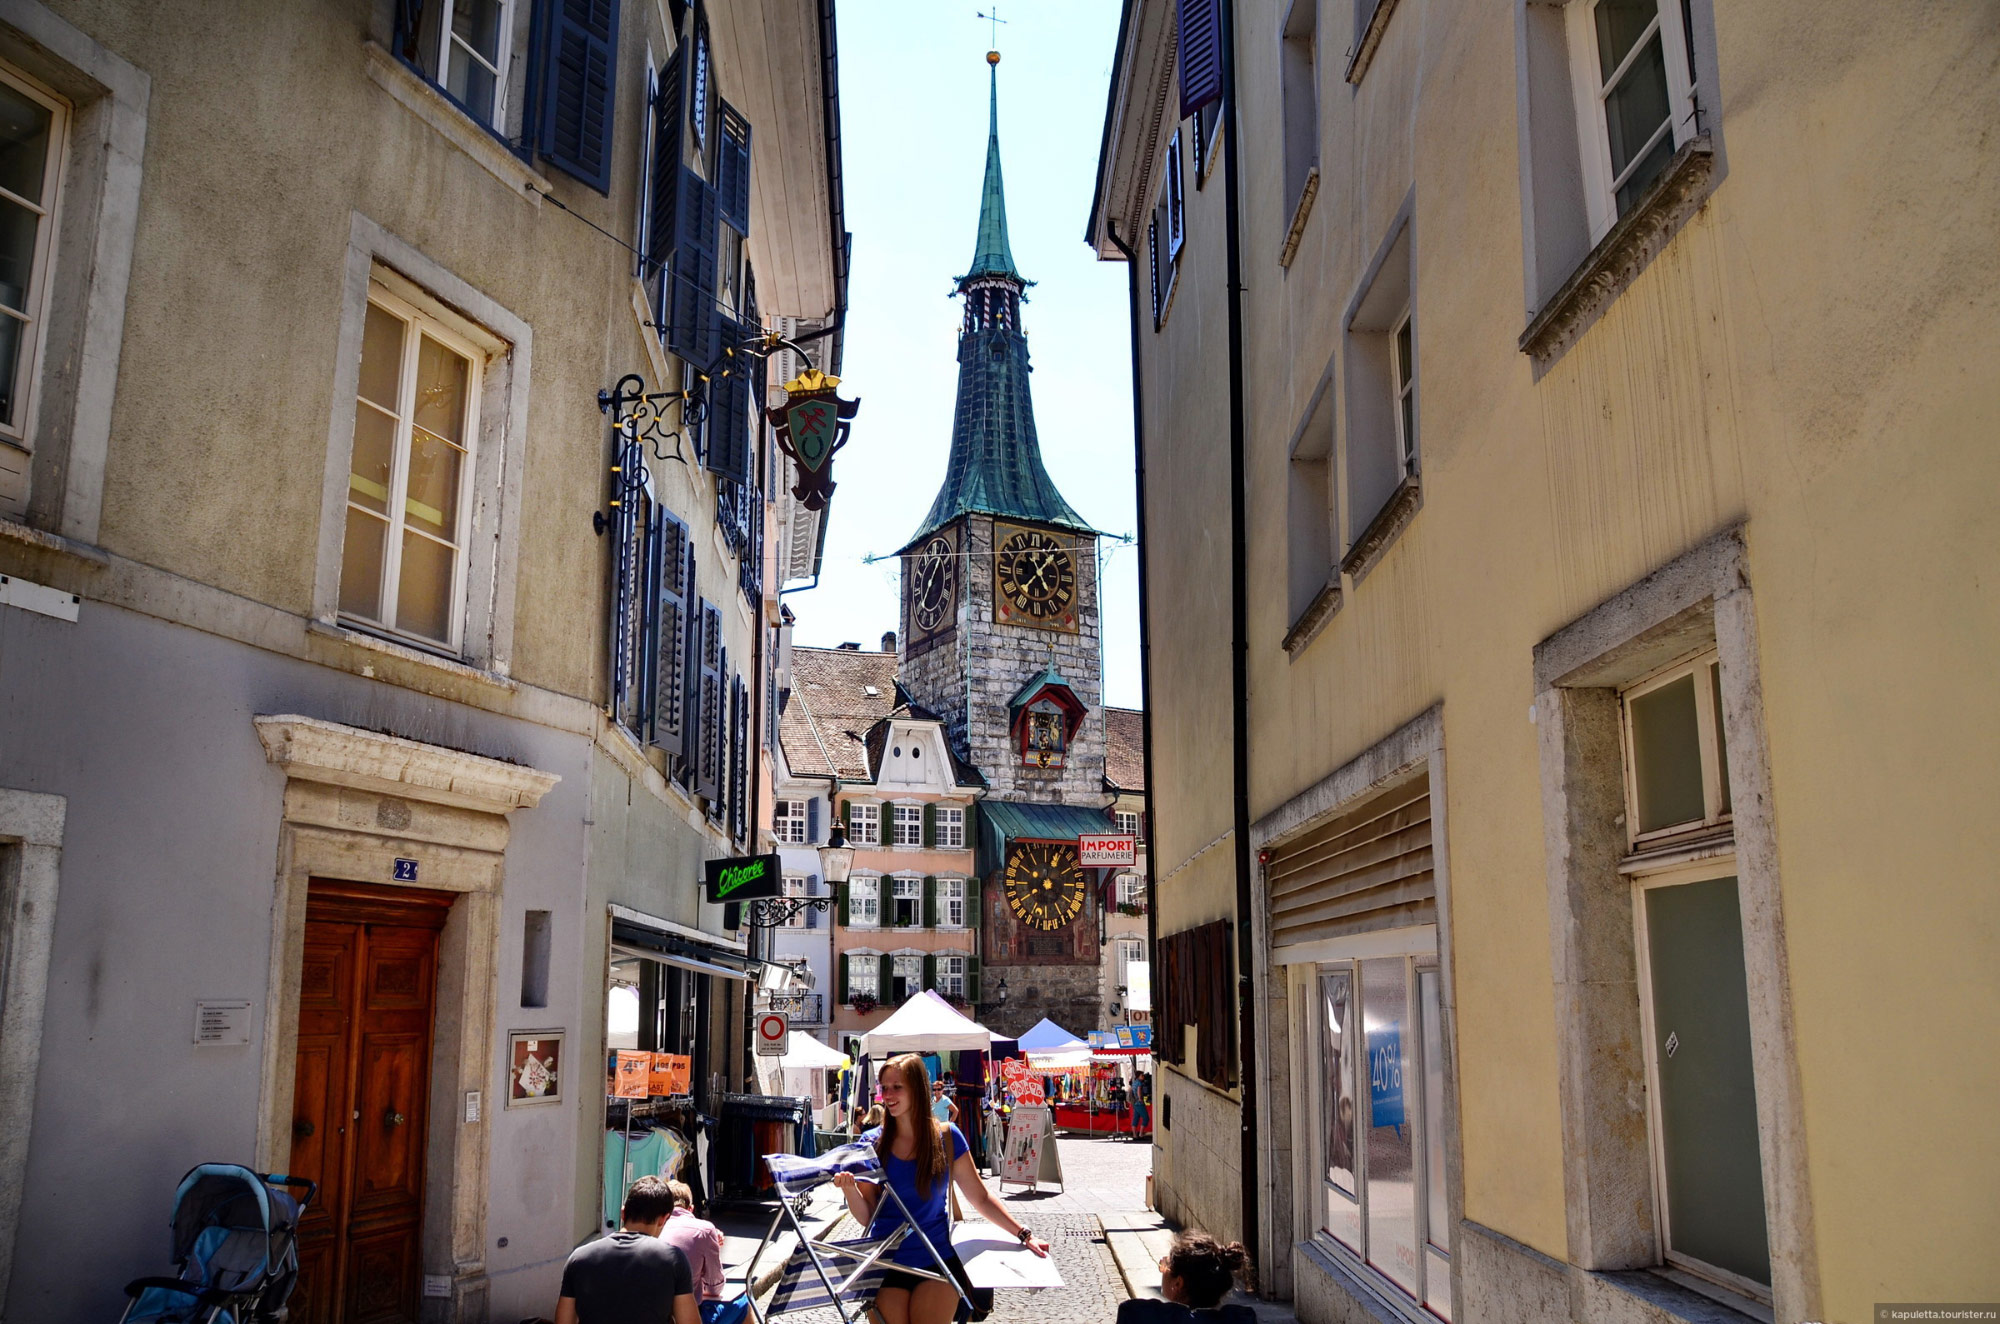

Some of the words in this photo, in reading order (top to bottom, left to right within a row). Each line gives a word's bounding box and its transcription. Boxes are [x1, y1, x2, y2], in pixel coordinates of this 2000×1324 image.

[1081, 840, 1133, 851] IMPORT
[1081, 851, 1133, 860] PARFUMERIE
[403, 862, 411, 878] 2
[1373, 1043, 1400, 1092] 40%
